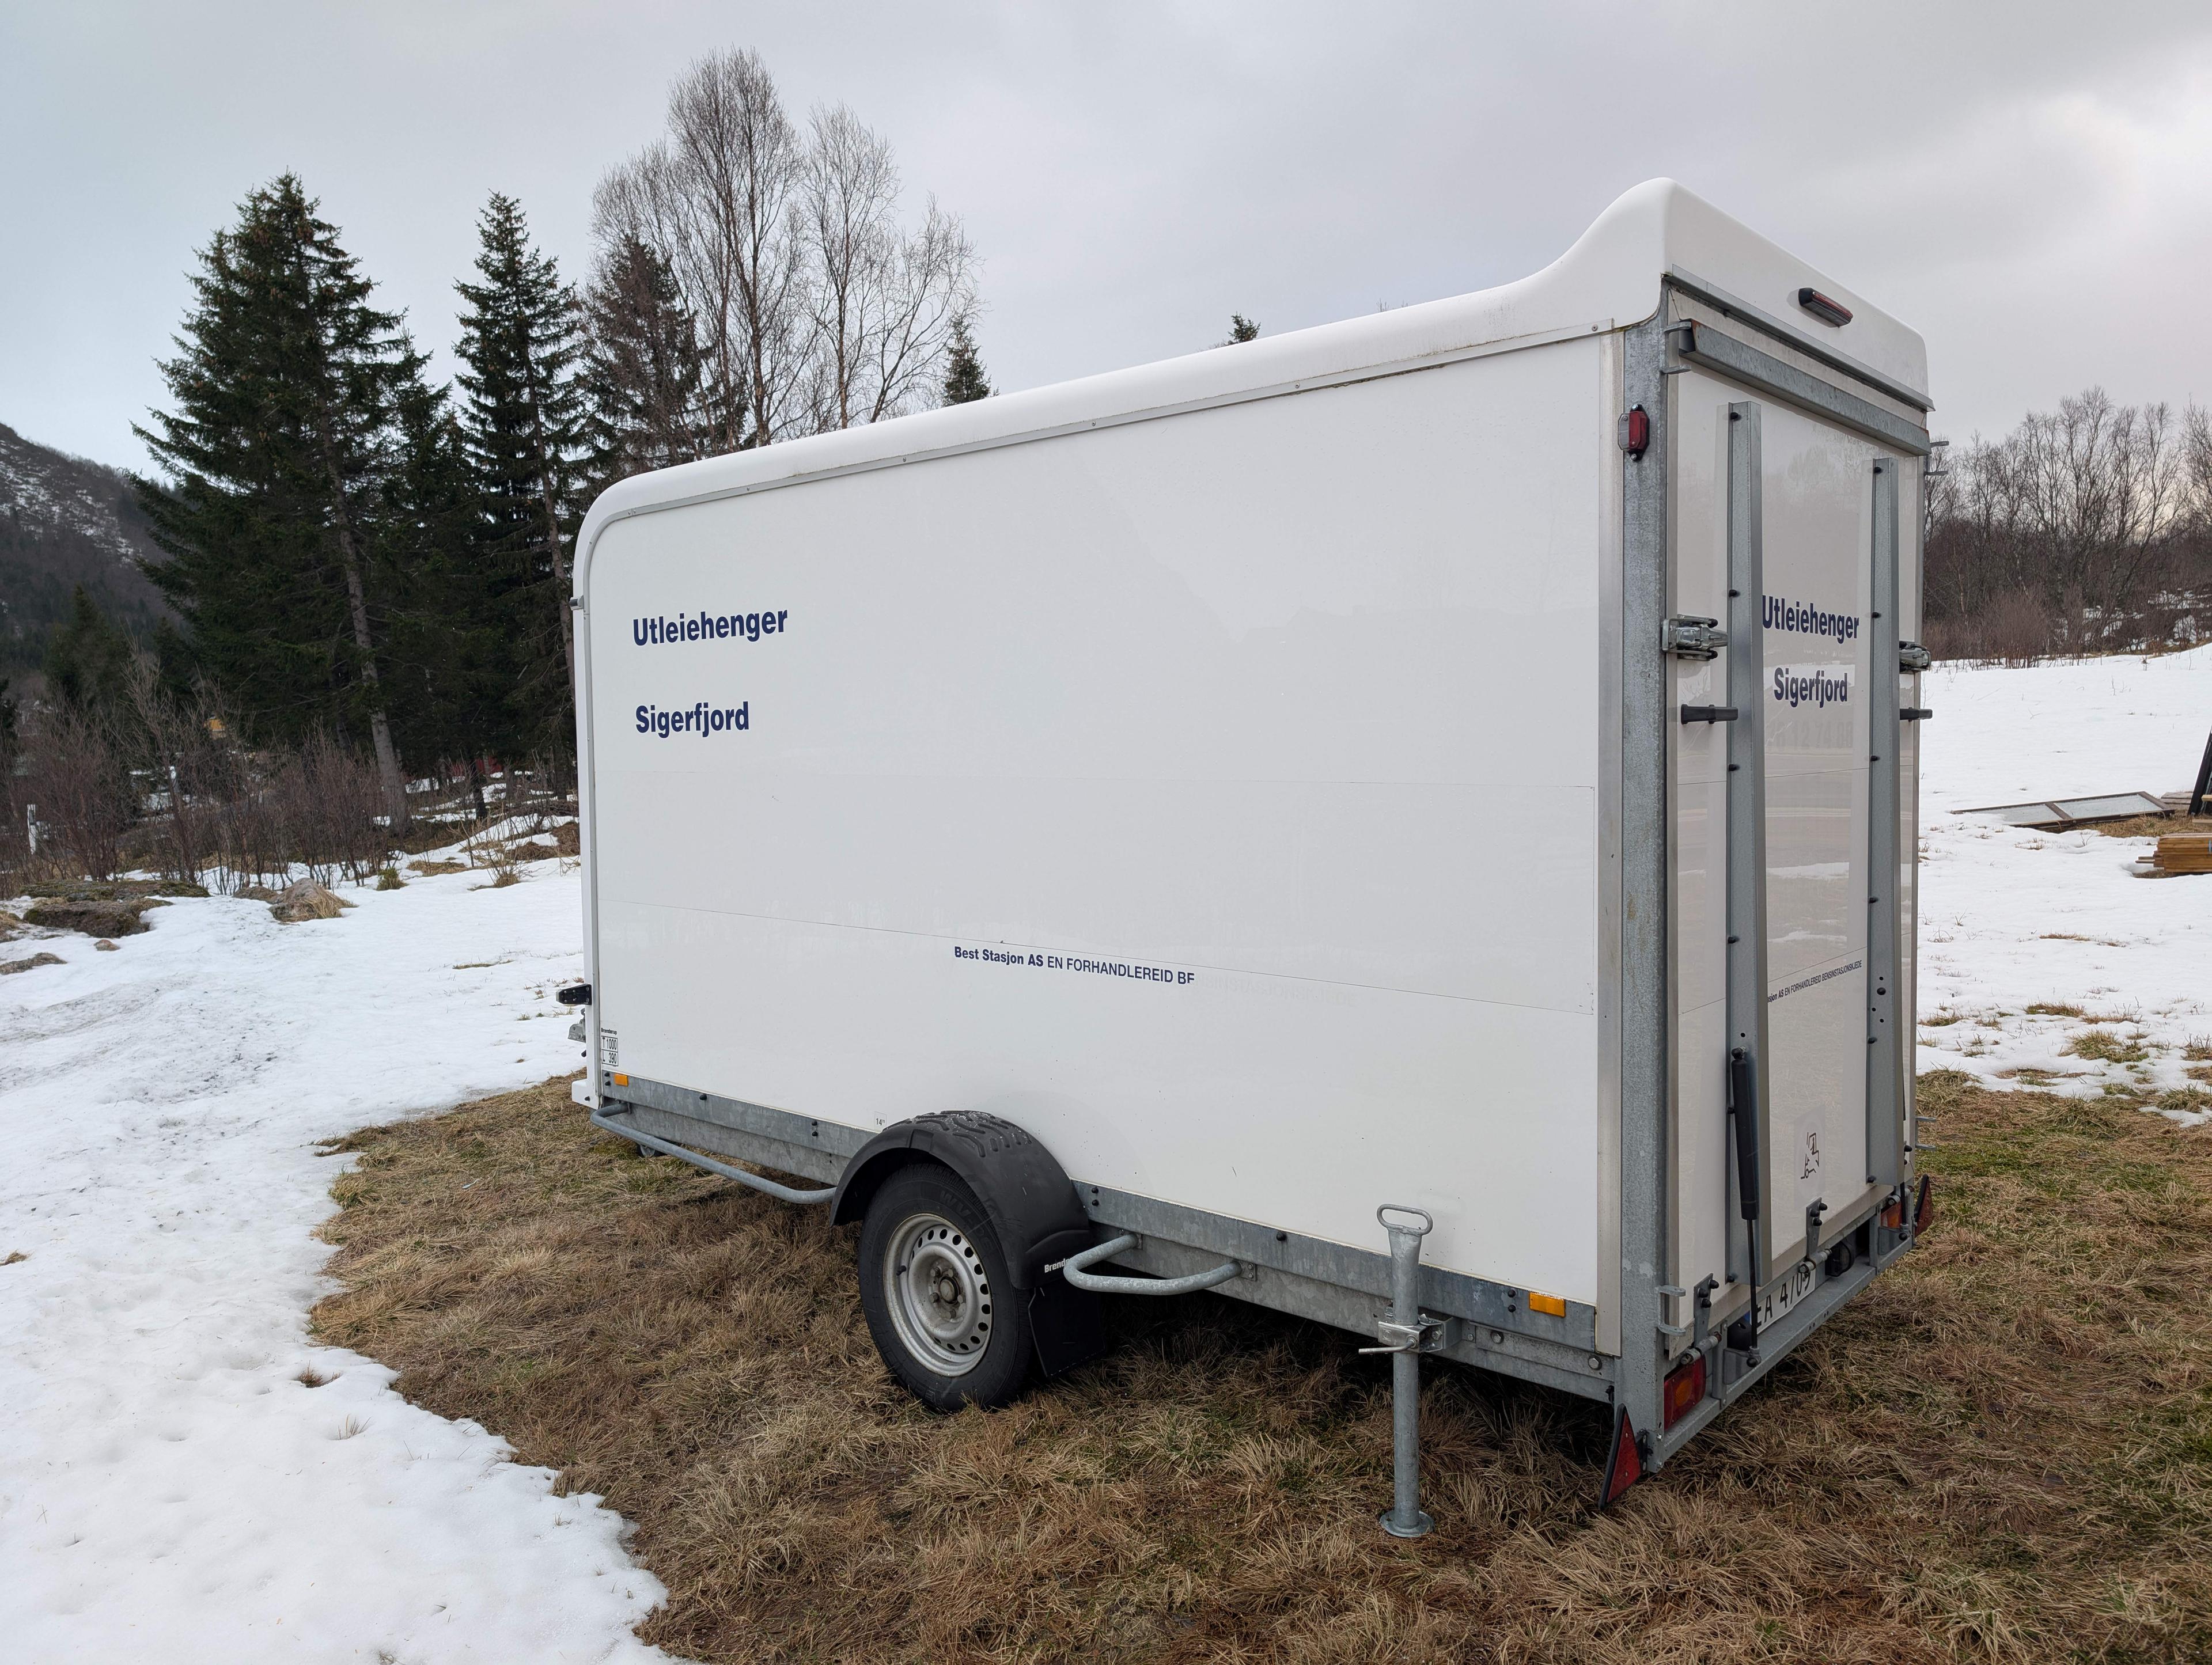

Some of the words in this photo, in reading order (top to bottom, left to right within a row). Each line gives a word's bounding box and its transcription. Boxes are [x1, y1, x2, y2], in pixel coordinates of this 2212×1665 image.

[632, 609, 787, 646] Utleiehenger
[1762, 595, 1859, 644] Utleiehenger
[1774, 667, 1847, 708] Sigerfjord
[635, 701, 749, 738] Sigerfjord
[954, 946, 979, 959] Best
[982, 949, 1024, 965] Stasjon
[1028, 953, 1043, 967] AS
[1047, 955, 1063, 969] EN
[1066, 958, 1173, 983] FORHANDLEREID
[1778, 989, 1783, 999] AS
[1785, 986, 1790, 996] EN
[1791, 976, 1821, 993] FORHANDLEREID
[607, 1038, 617, 1050] 1000
[608, 1052, 617, 1064] 390
